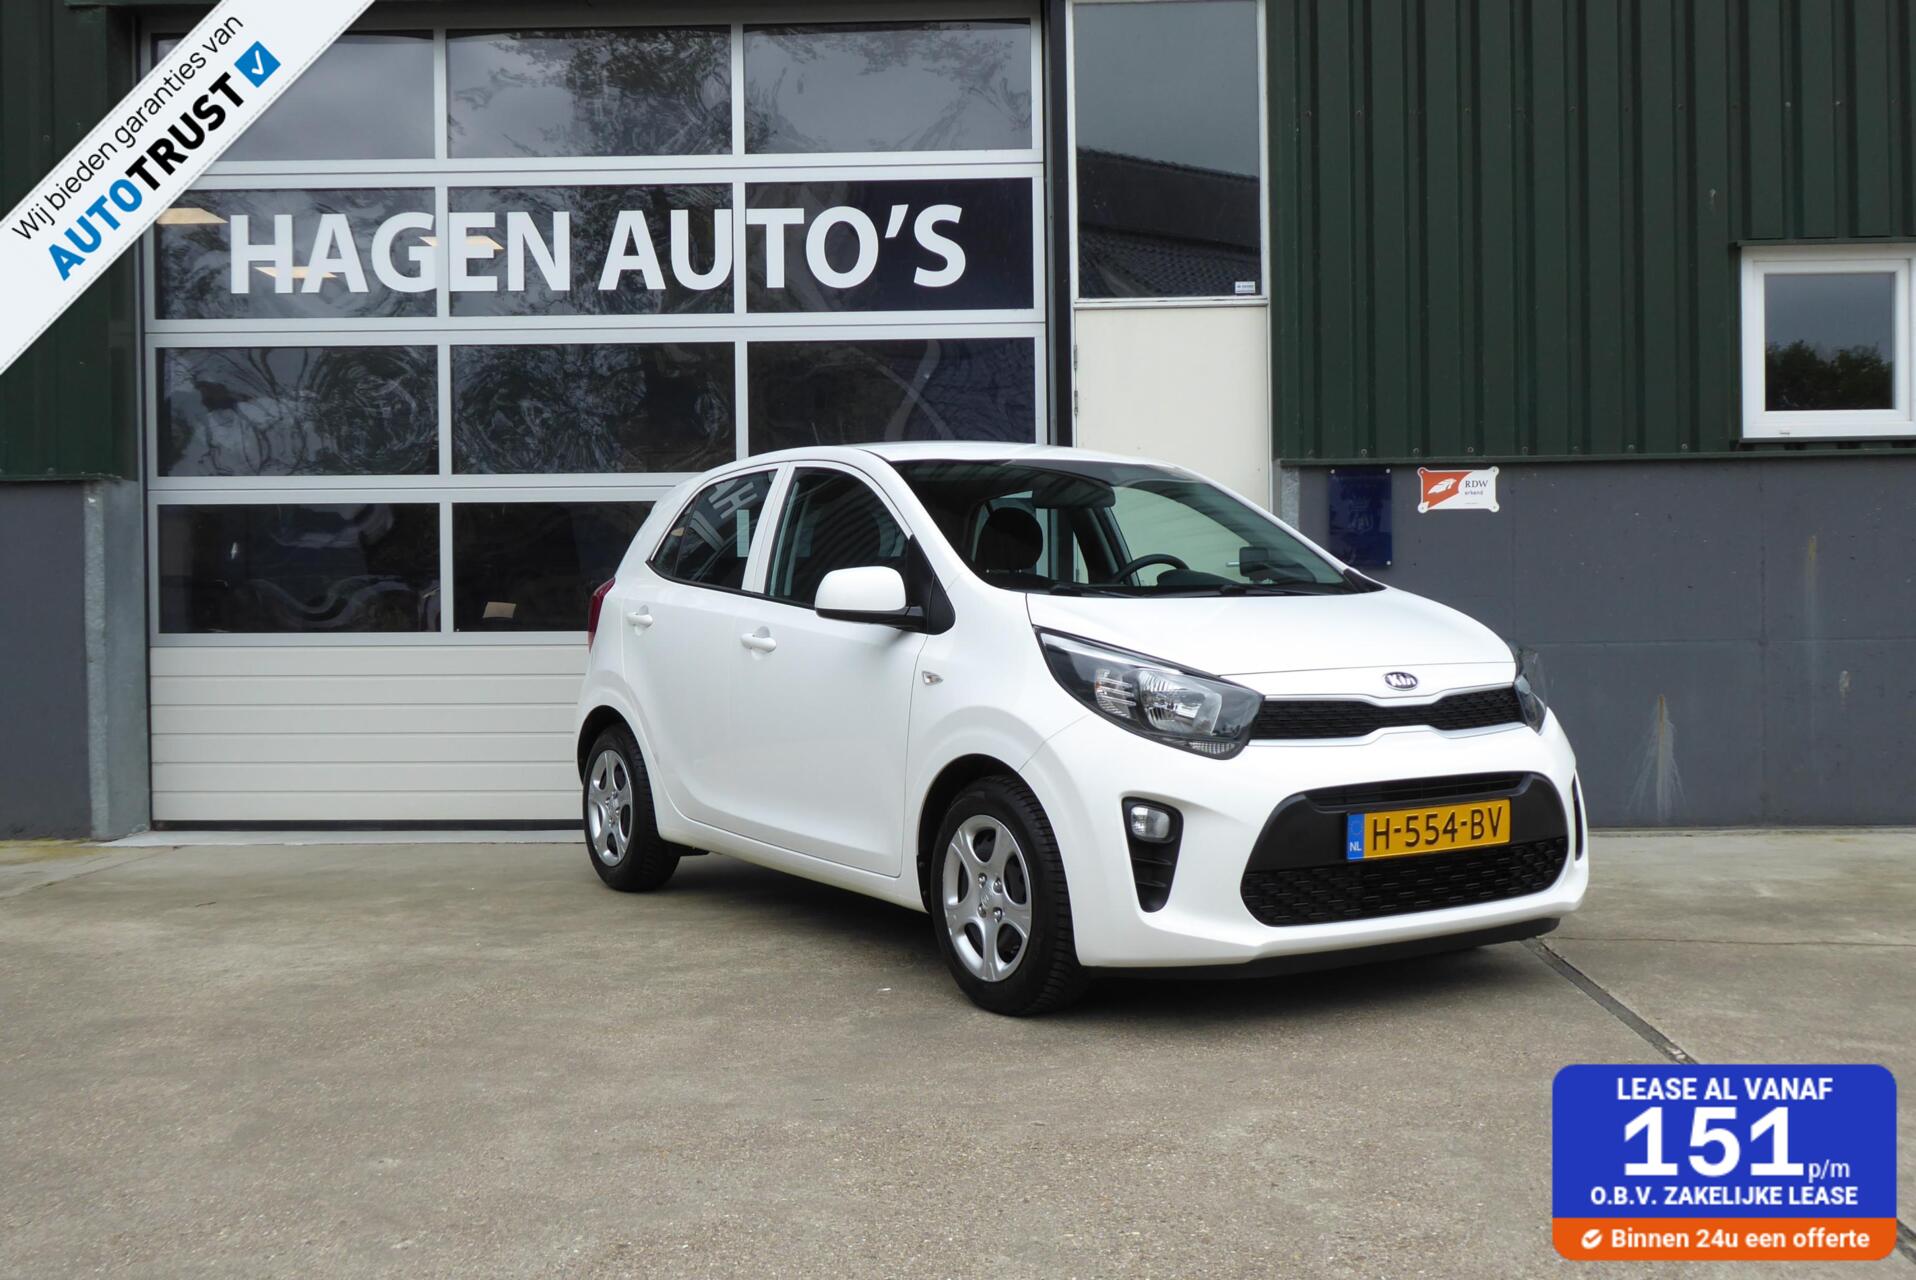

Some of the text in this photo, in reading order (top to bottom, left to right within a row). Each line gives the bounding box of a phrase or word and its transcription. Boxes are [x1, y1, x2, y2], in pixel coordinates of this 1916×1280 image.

[230, 204, 967, 294] HAGEN AUTO'S
[1465, 480, 1488, 488] RDW
[1350, 806, 1502, 852] NL H-554-BV
